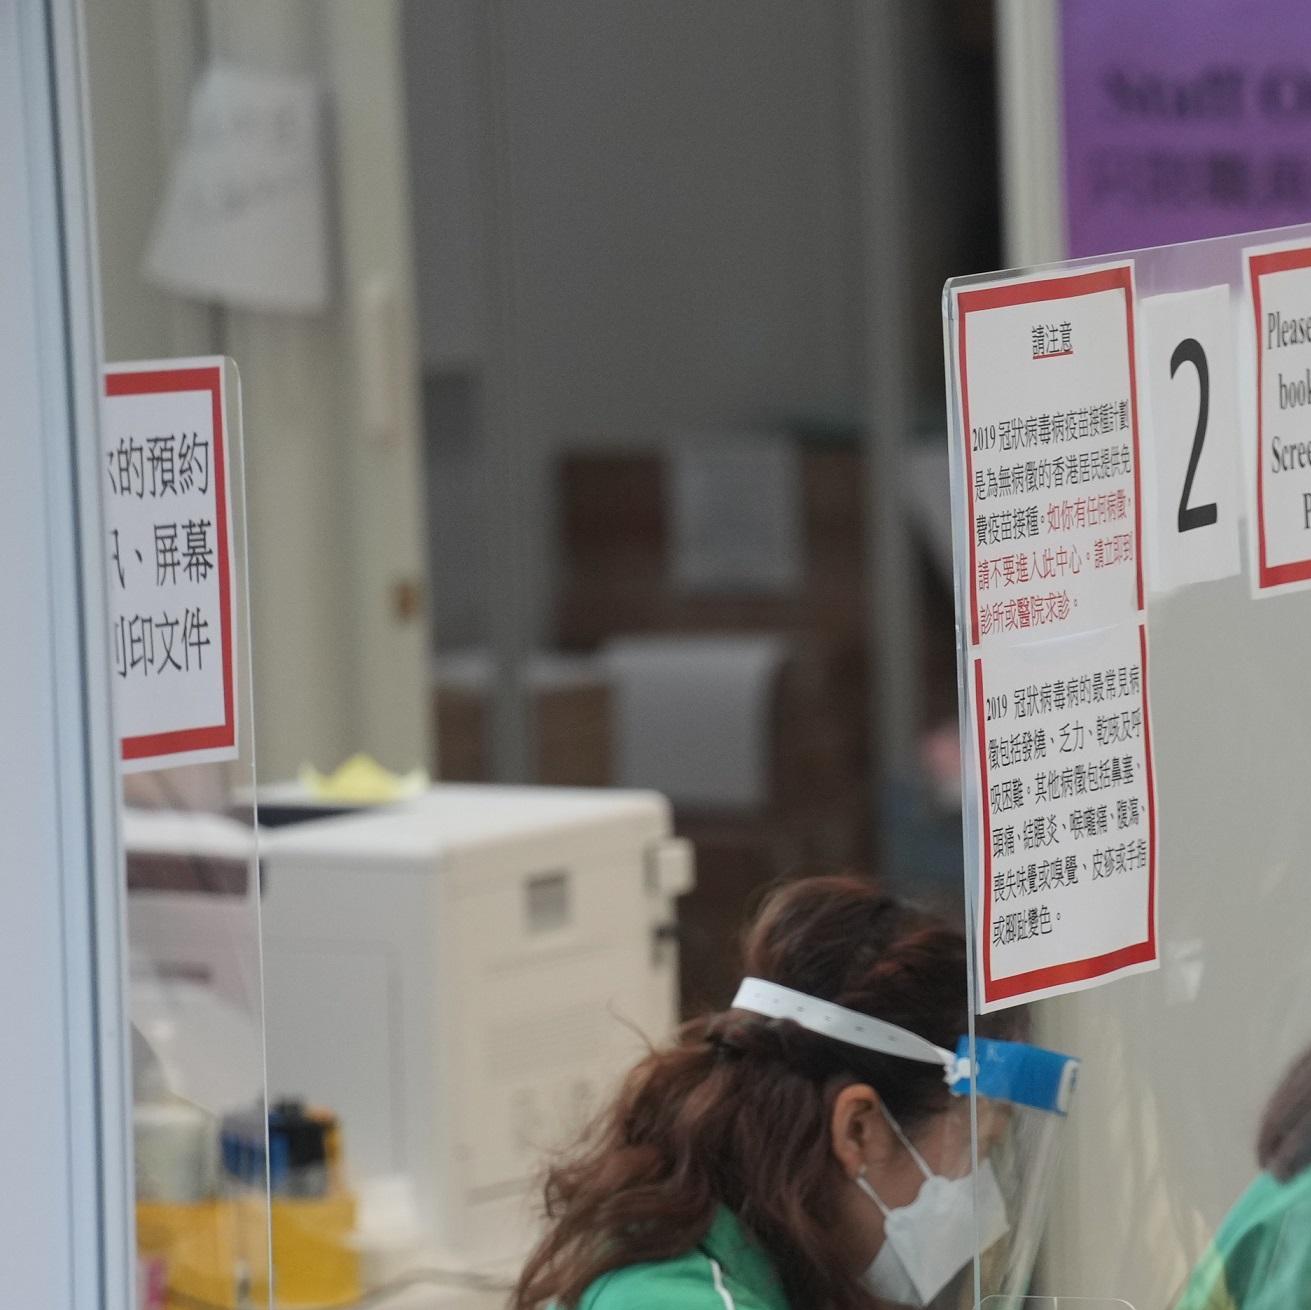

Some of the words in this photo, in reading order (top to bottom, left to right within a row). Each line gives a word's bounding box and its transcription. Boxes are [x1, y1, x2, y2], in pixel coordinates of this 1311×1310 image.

[1032, 321, 1072, 354] 請注意
[1170, 338, 1217, 533] 2
